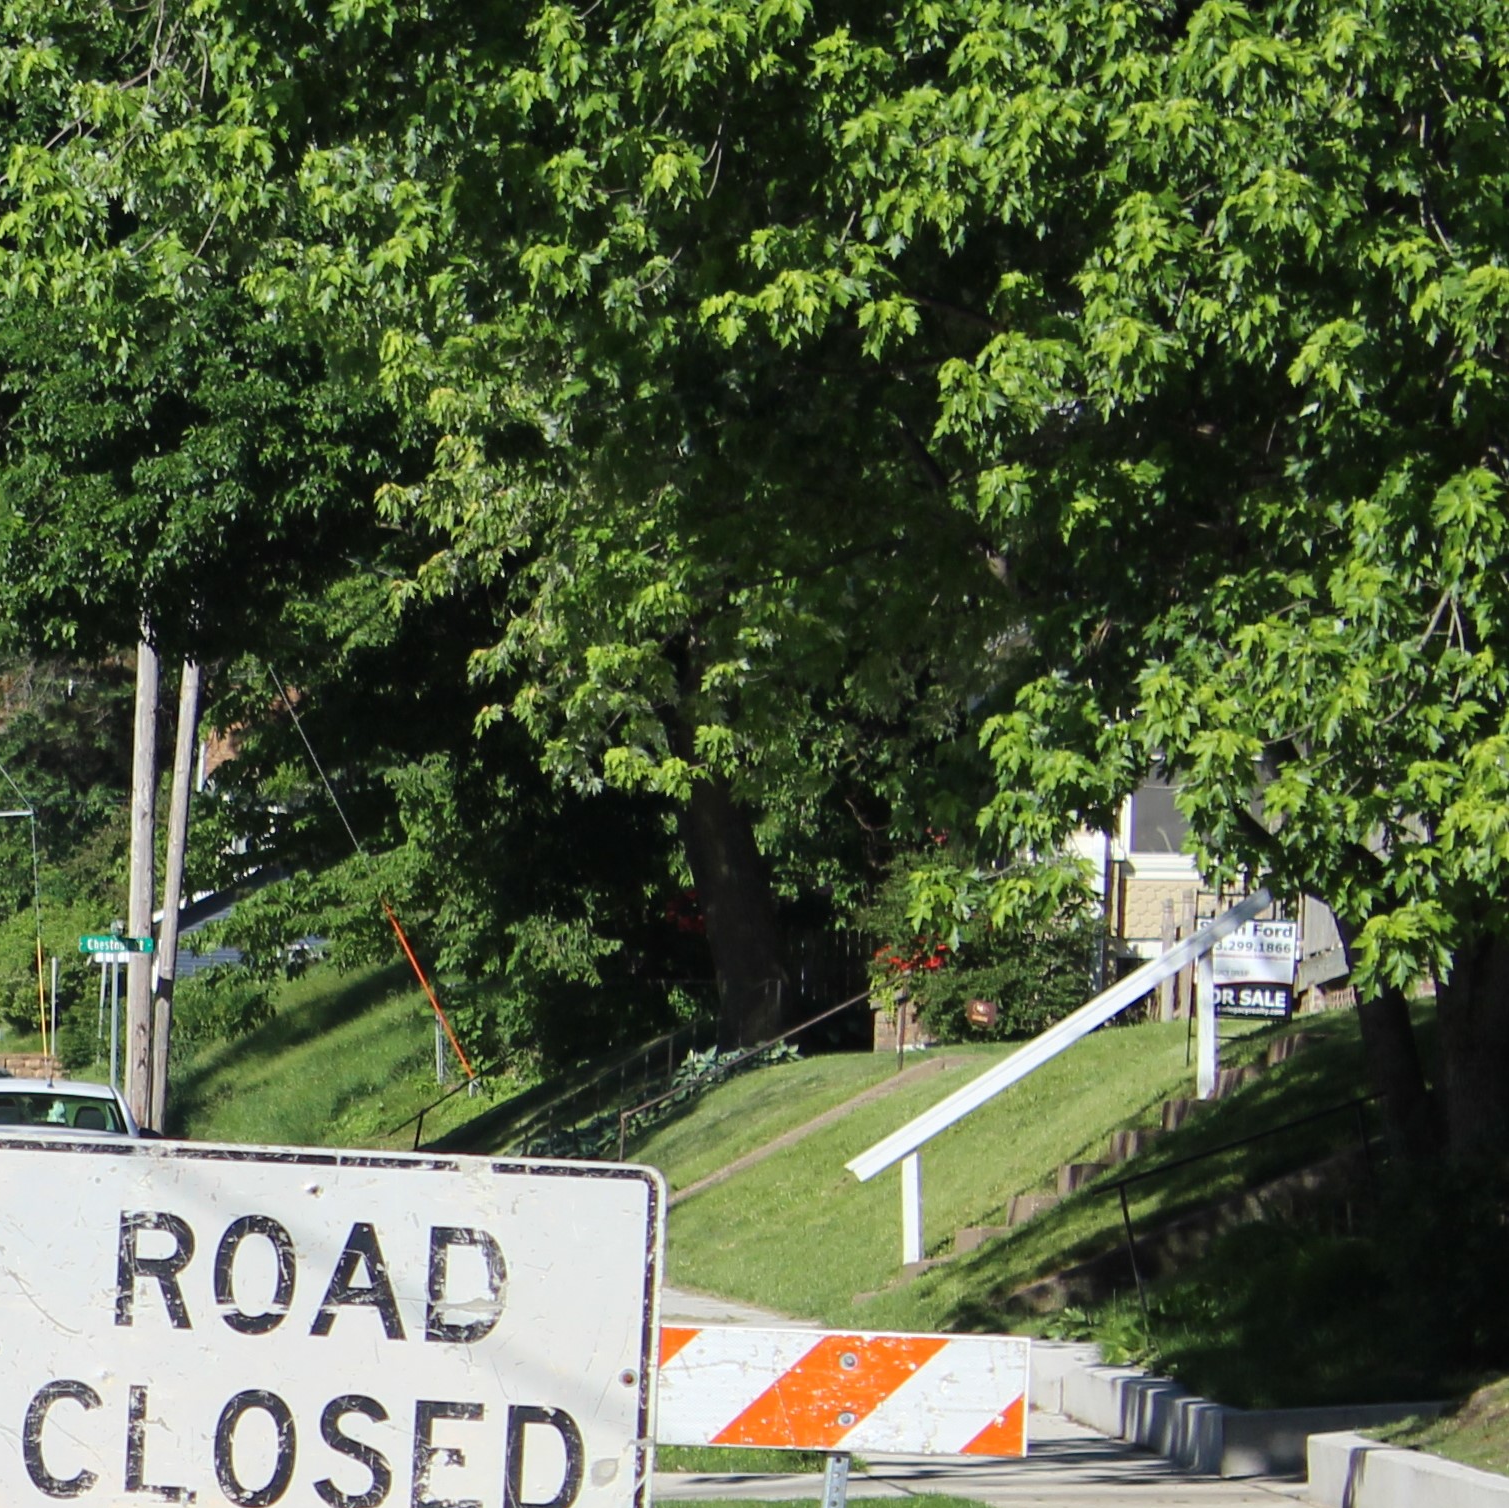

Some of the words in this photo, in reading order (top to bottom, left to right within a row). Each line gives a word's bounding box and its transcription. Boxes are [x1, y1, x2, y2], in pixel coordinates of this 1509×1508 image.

[1252, 923, 1293, 938] Ford
[1213, 987, 1236, 1005] OR
[1239, 989, 1287, 1008] SALE
[113, 1208, 508, 1344] ROAD
